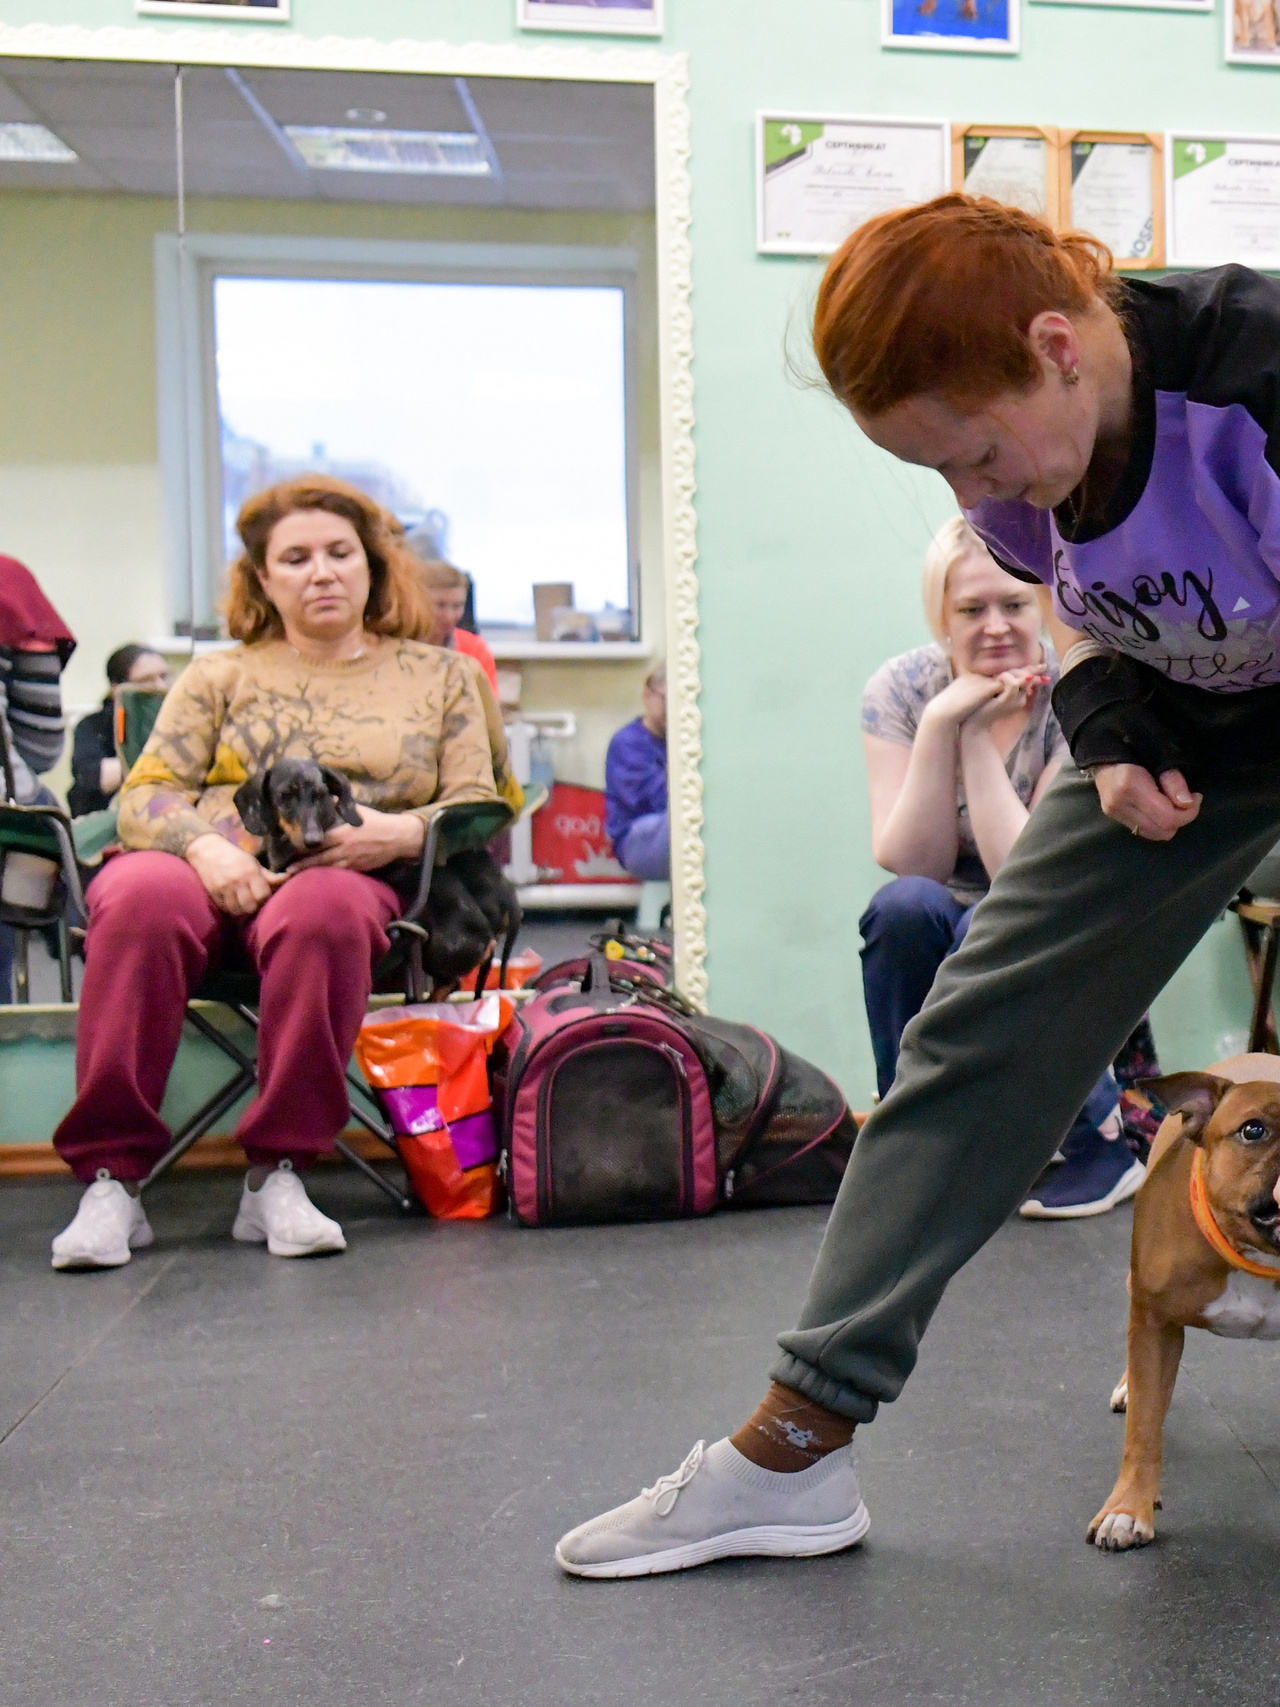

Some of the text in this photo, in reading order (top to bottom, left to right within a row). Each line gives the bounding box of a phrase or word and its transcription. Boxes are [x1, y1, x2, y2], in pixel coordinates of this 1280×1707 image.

[825, 140, 887, 151] СЕРТИФИКАТ
[1055, 549, 1228, 642] Enjoy
[1082, 621, 1146, 650] the
